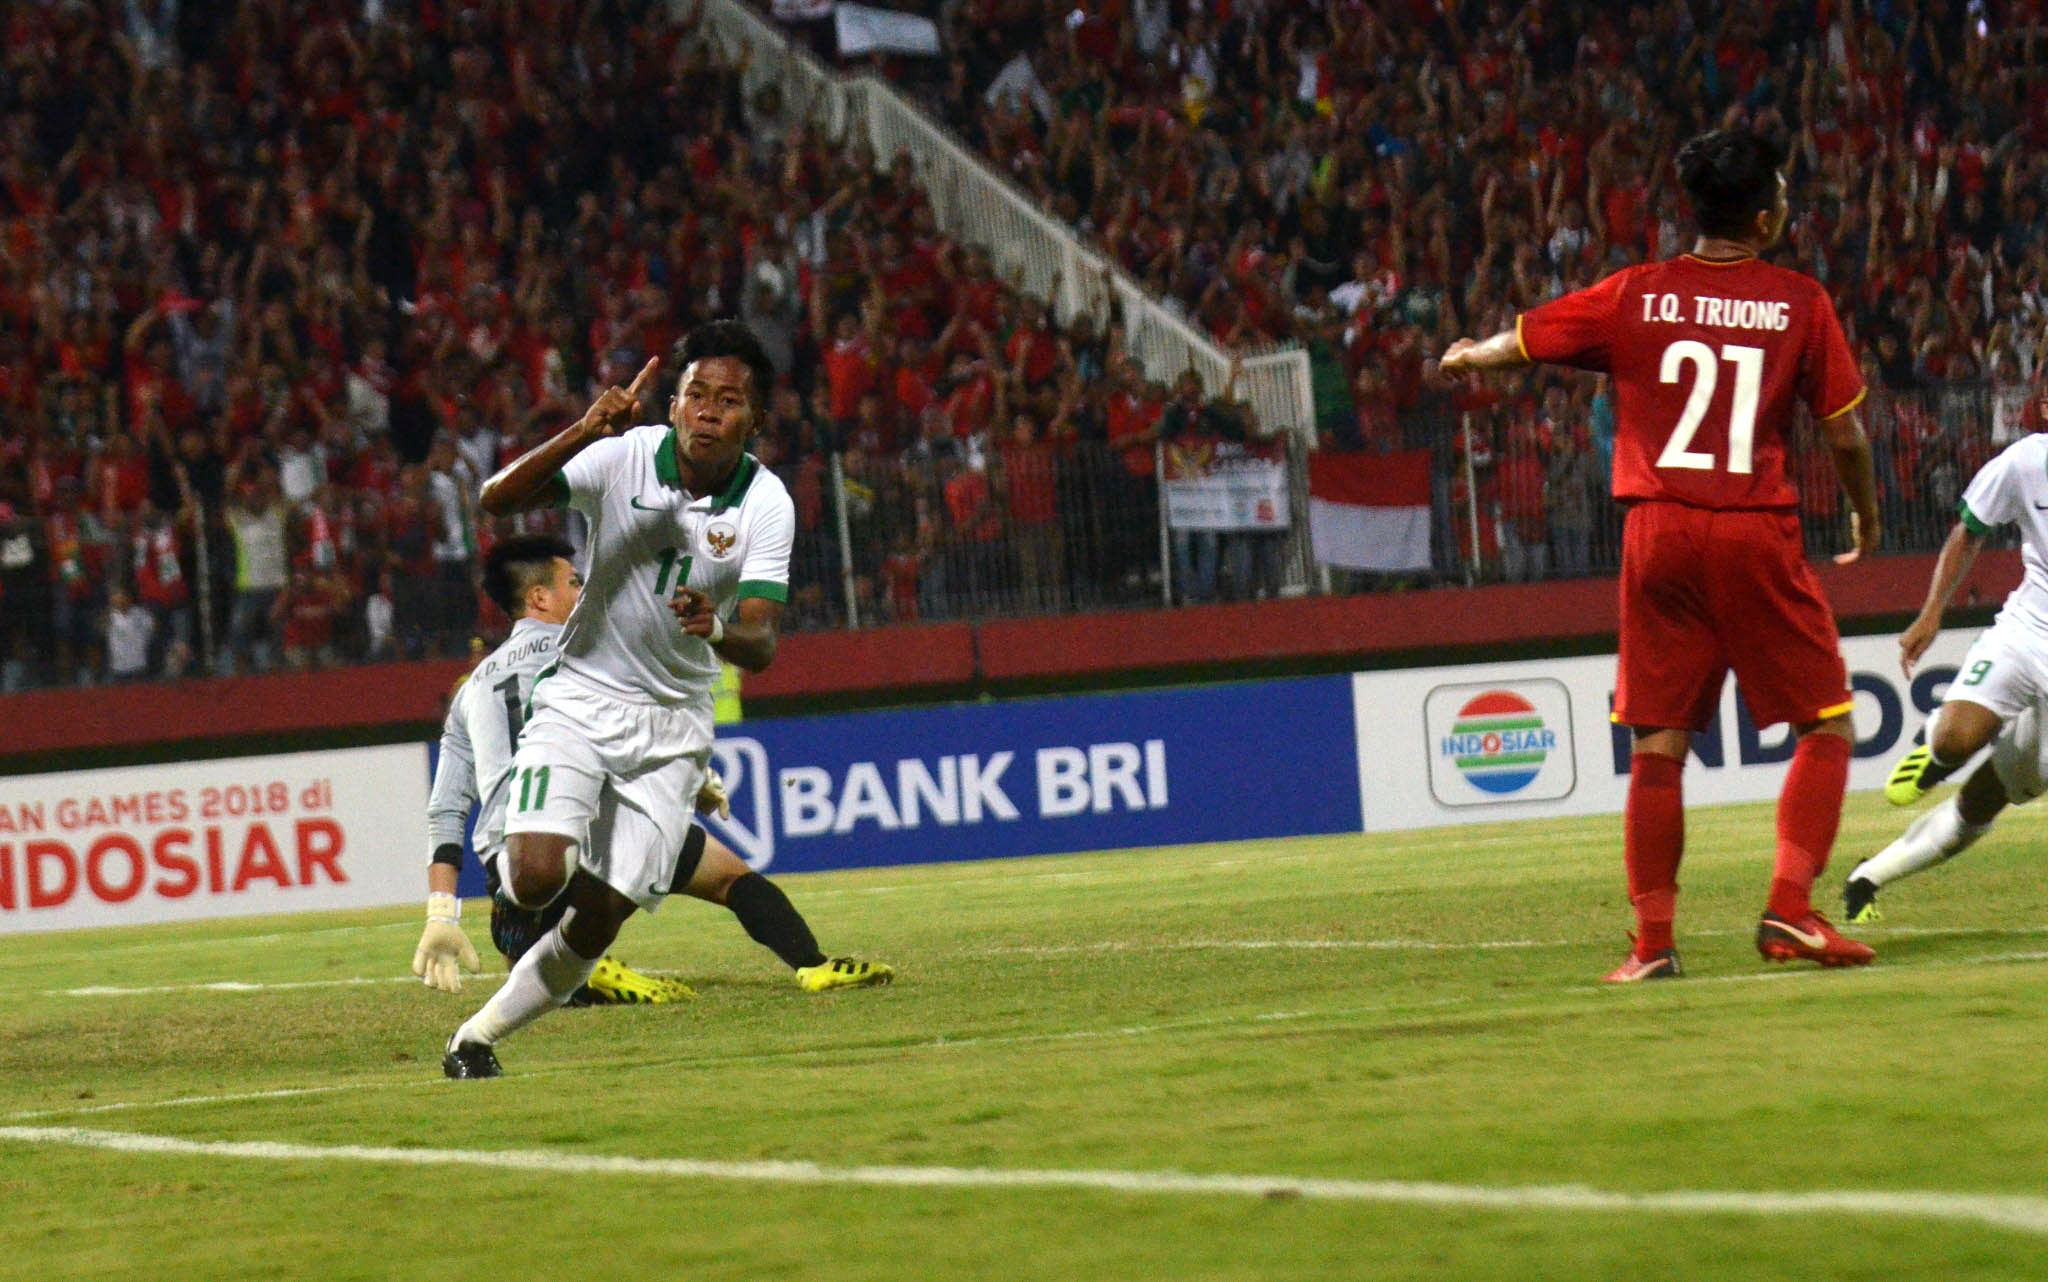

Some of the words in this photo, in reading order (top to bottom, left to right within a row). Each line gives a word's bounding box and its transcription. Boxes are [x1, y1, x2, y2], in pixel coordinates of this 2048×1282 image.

[1642, 292, 1686, 324] T.Q.
[1693, 296, 1791, 332] TRUONG
[1655, 340, 1765, 475] 21
[654, 546, 692, 595] 11
[507, 636, 551, 667] DUNG
[1963, 659, 1994, 687] 9
[1440, 728, 1557, 758] INDOSIAR
[56, 788, 190, 832] GAMES
[200, 781, 290, 818] 2018
[300, 778, 332, 809] di
[518, 765, 551, 813] 11
[779, 751, 1020, 838] BANK
[1035, 738, 1170, 819] BRI
